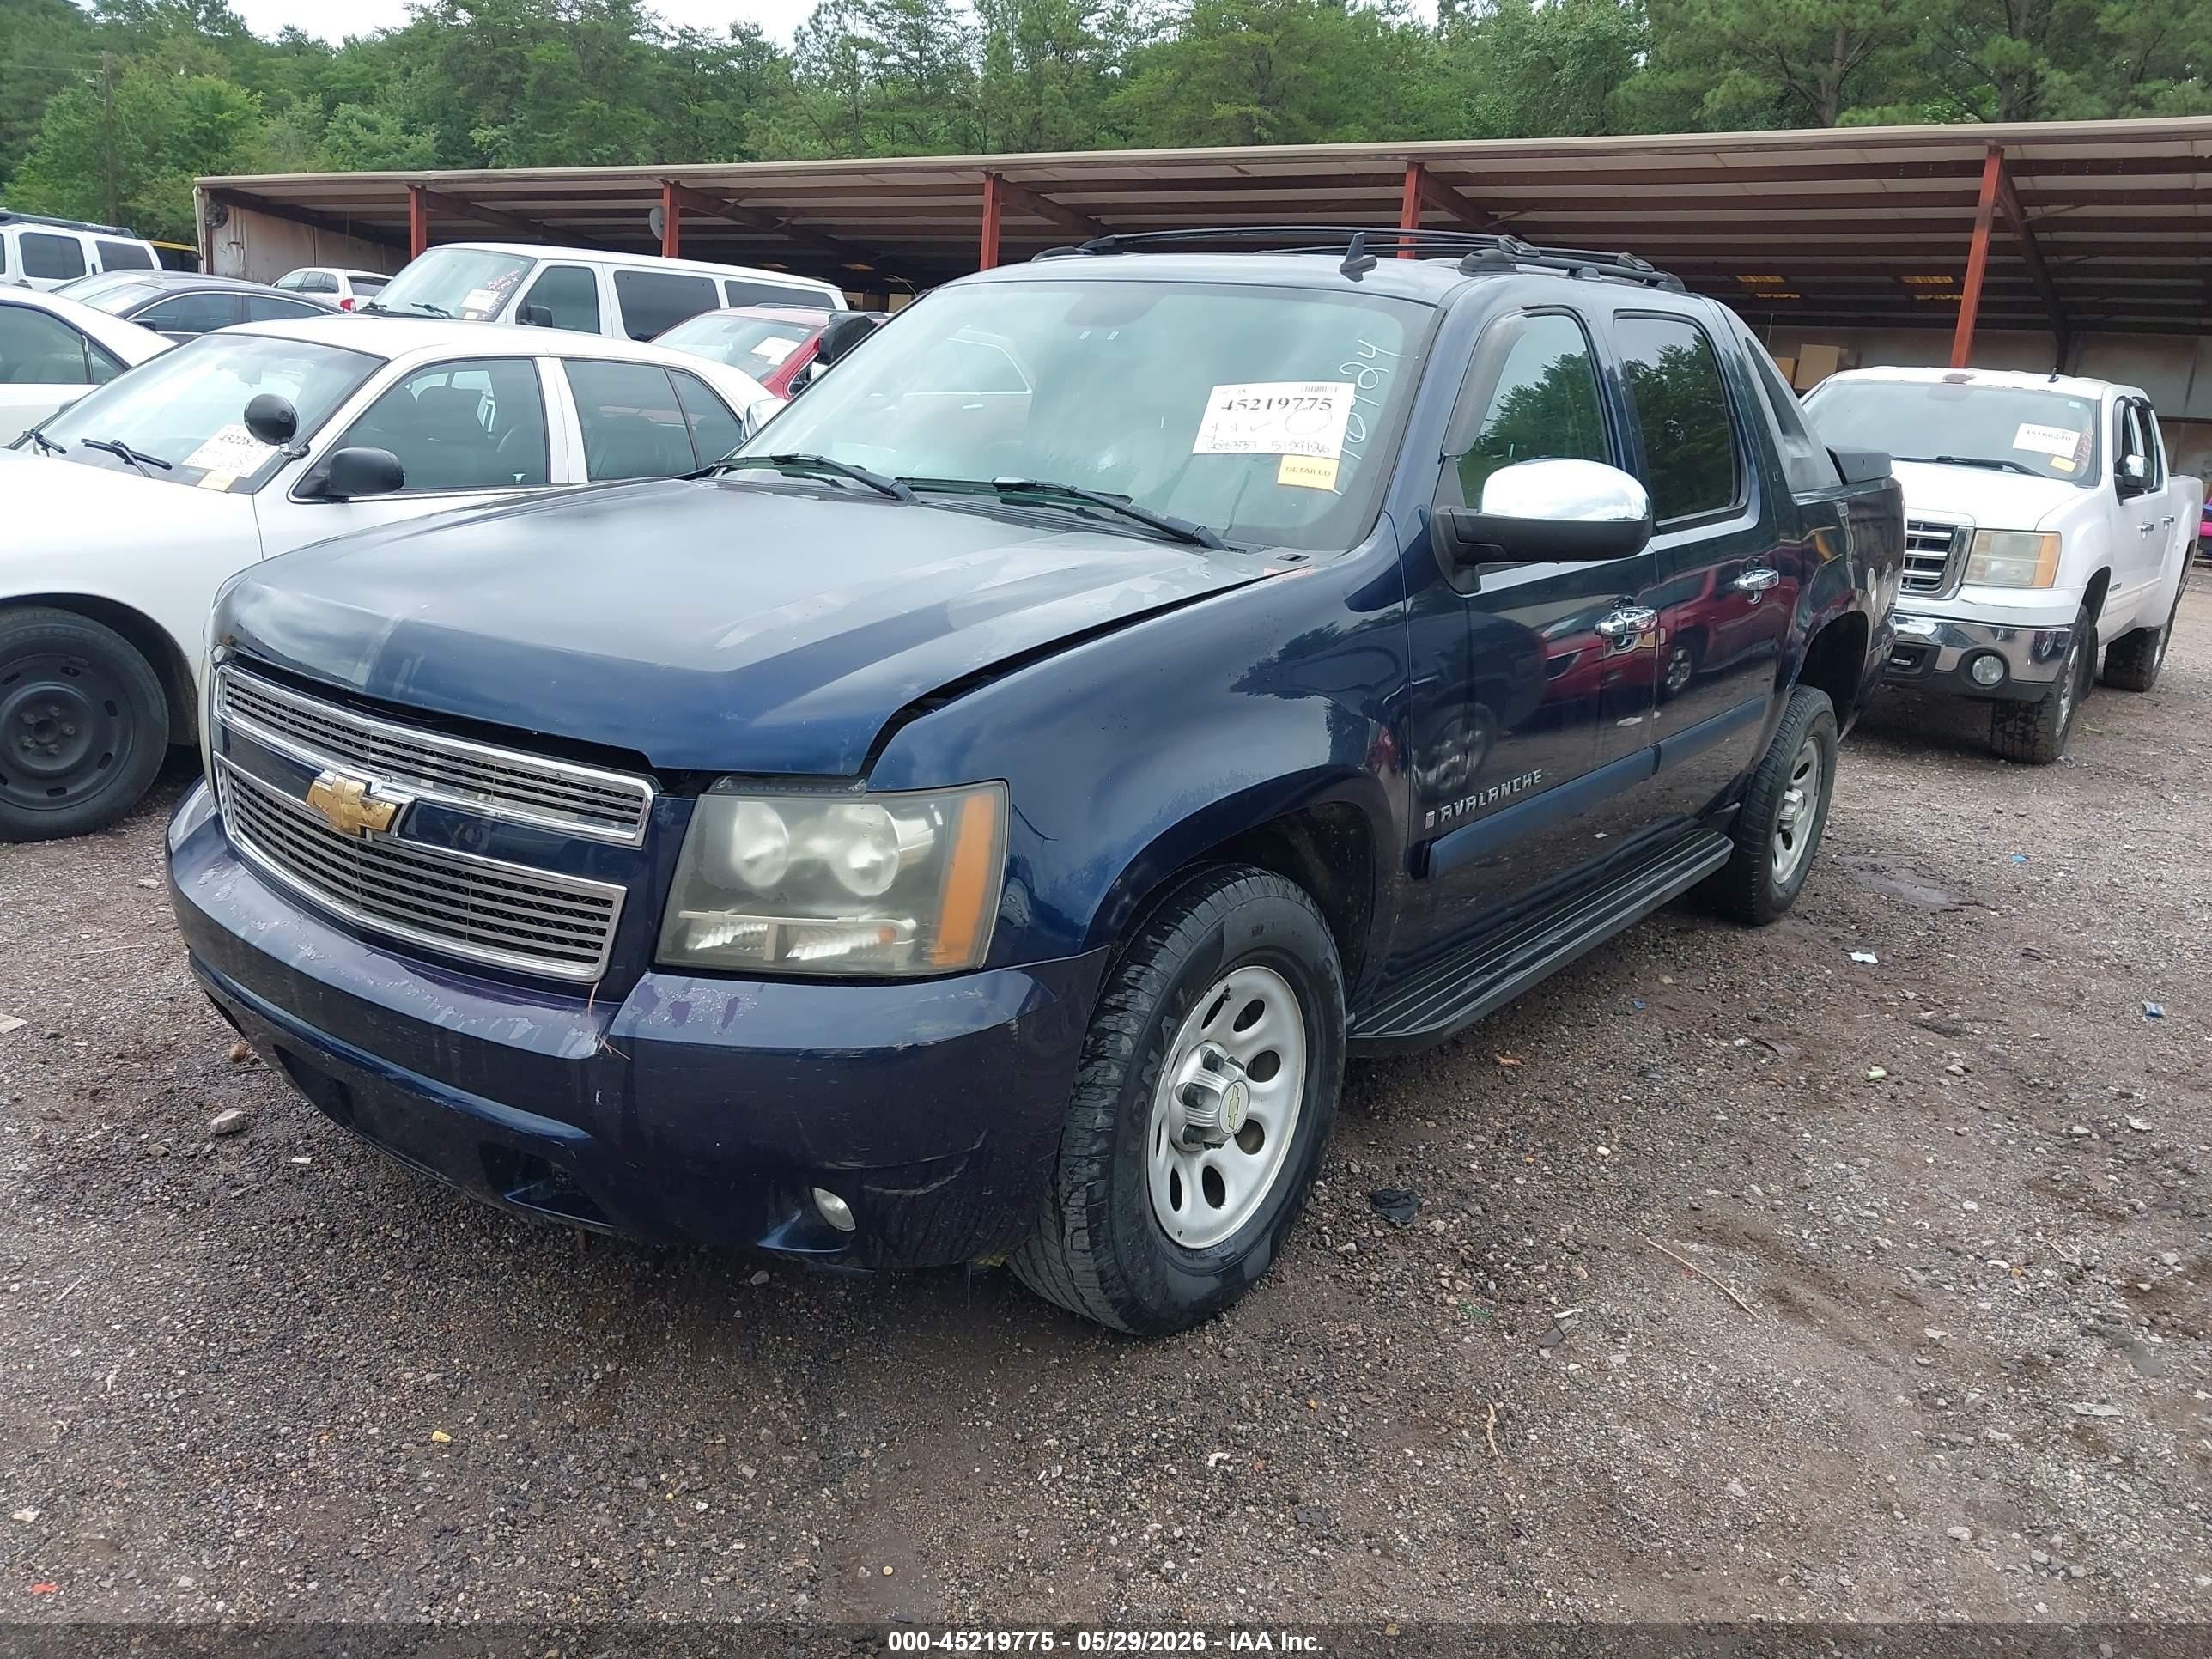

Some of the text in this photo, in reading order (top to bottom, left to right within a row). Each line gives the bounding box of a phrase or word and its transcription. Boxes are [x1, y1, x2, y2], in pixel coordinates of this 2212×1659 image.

[1220, 398, 1334, 412] 45219775
[1285, 465, 1332, 477] DETAILED
[1440, 769, 1543, 823] AVALANCHE
